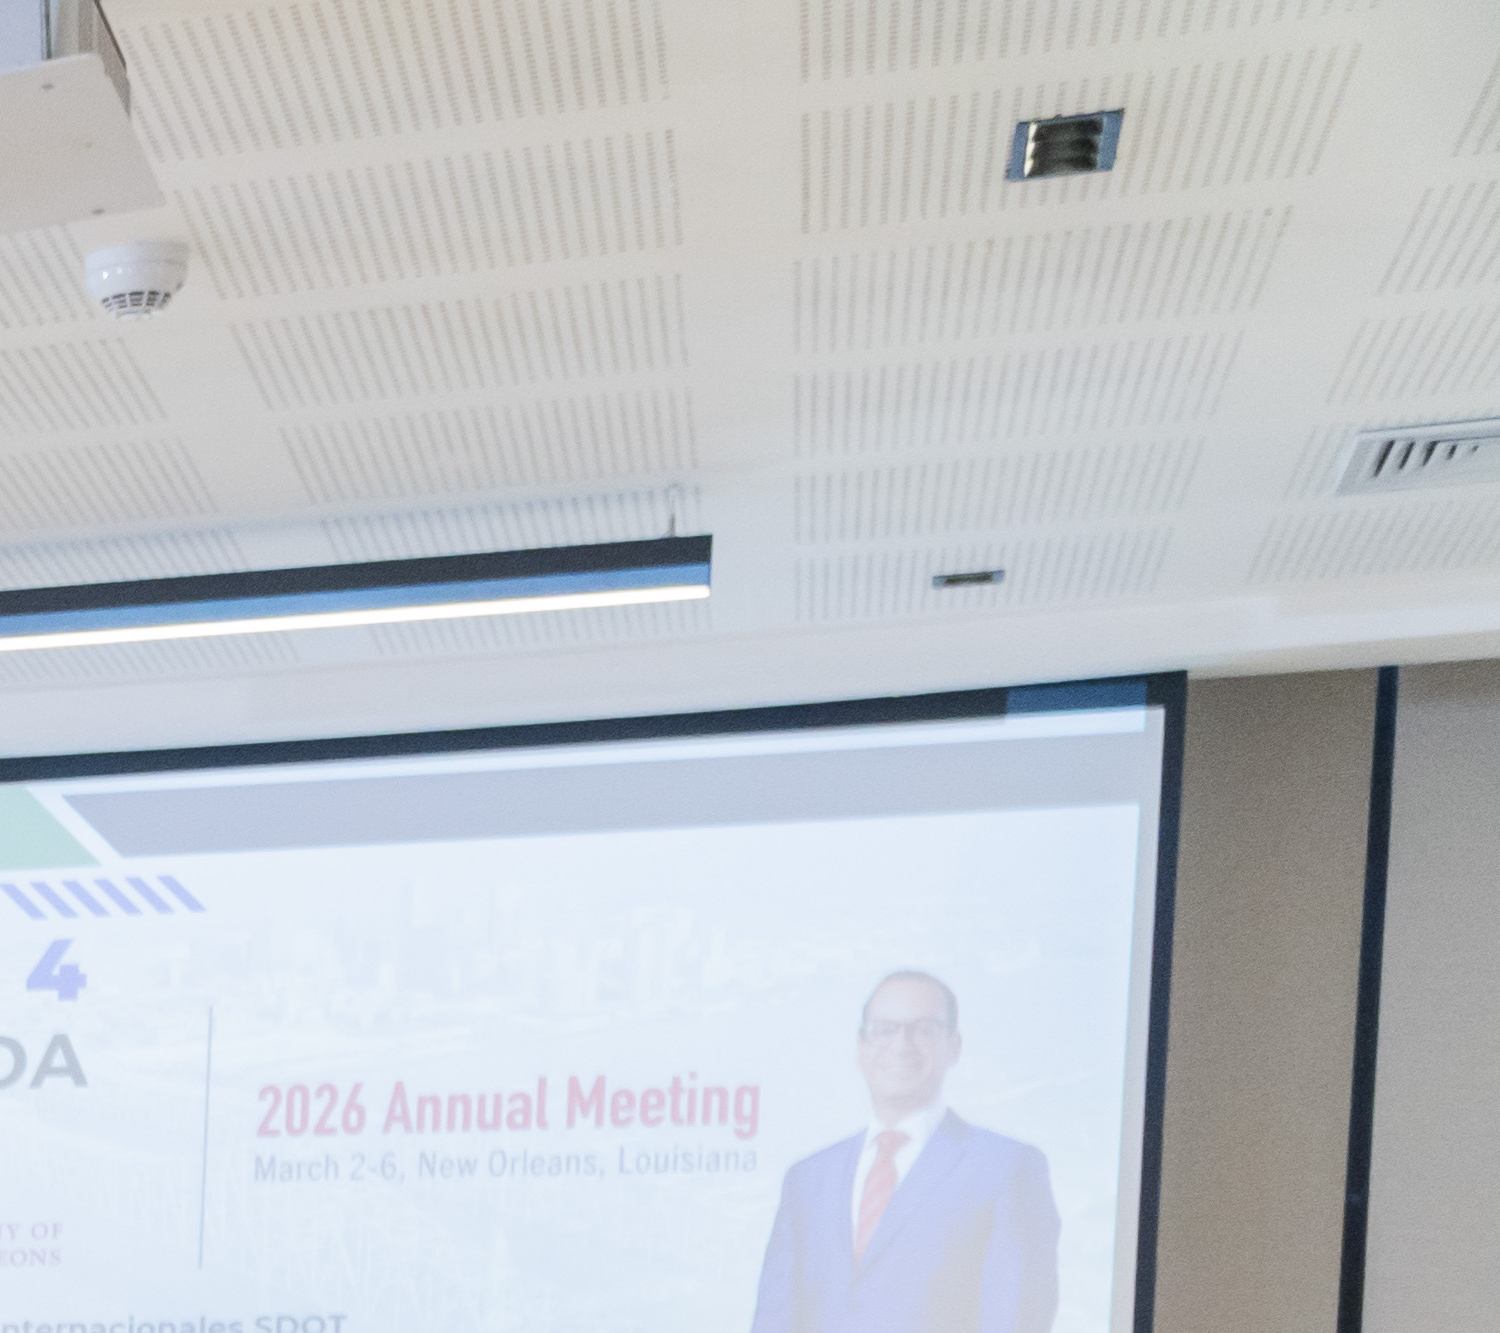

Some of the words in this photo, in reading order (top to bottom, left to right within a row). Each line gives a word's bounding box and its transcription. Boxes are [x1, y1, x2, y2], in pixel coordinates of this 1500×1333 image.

[25, 938, 88, 1002] 4
[256, 1082, 367, 1138] 2026
[382, 1076, 548, 1134] Annual
[565, 1071, 761, 1141] Meeting
[253, 1153, 339, 1183] March
[349, 1150, 406, 1183] 2-6,
[418, 1150, 479, 1180] New
[488, 1148, 606, 1180] Orleans,
[618, 1144, 758, 1176] Louisiana
